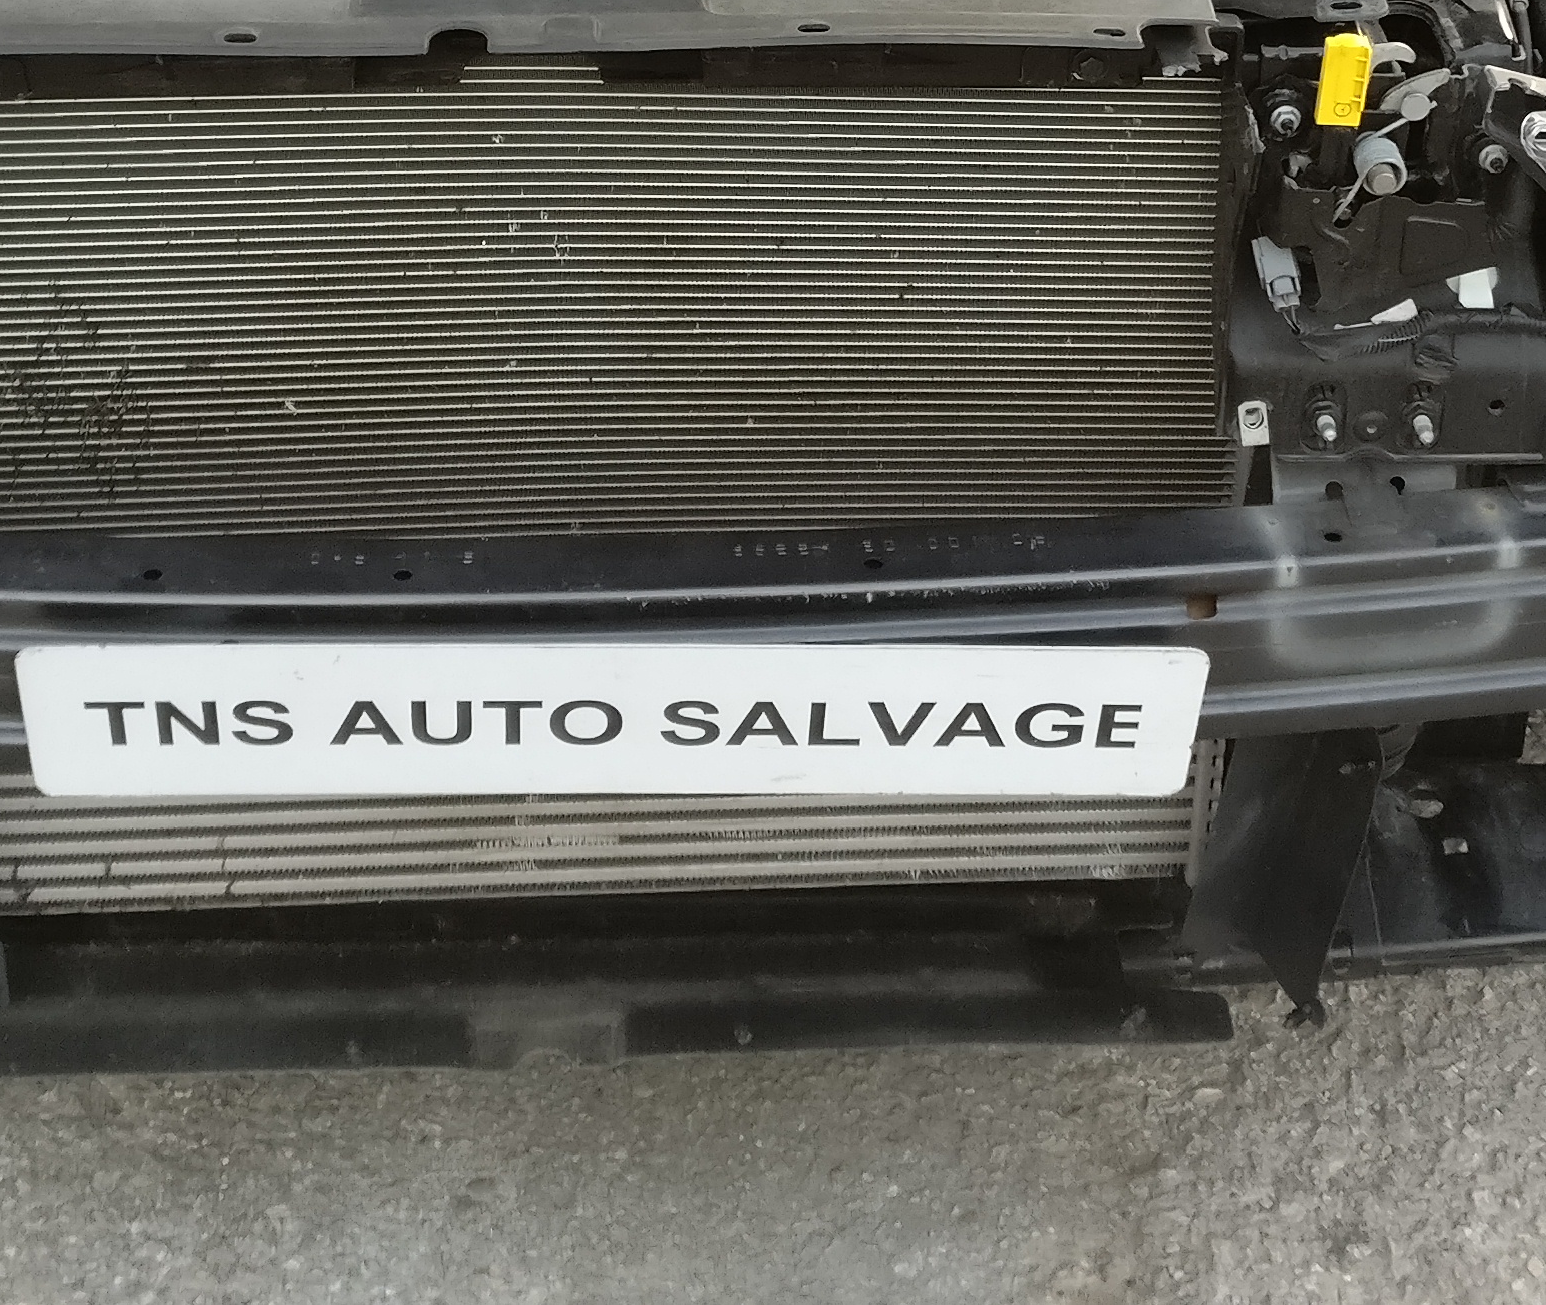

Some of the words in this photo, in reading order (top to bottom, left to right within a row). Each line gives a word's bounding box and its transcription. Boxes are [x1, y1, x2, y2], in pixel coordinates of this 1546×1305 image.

[83, 700, 294, 746] TNS
[330, 700, 623, 746] AUTO
[660, 700, 1143, 749] SALVAGE
